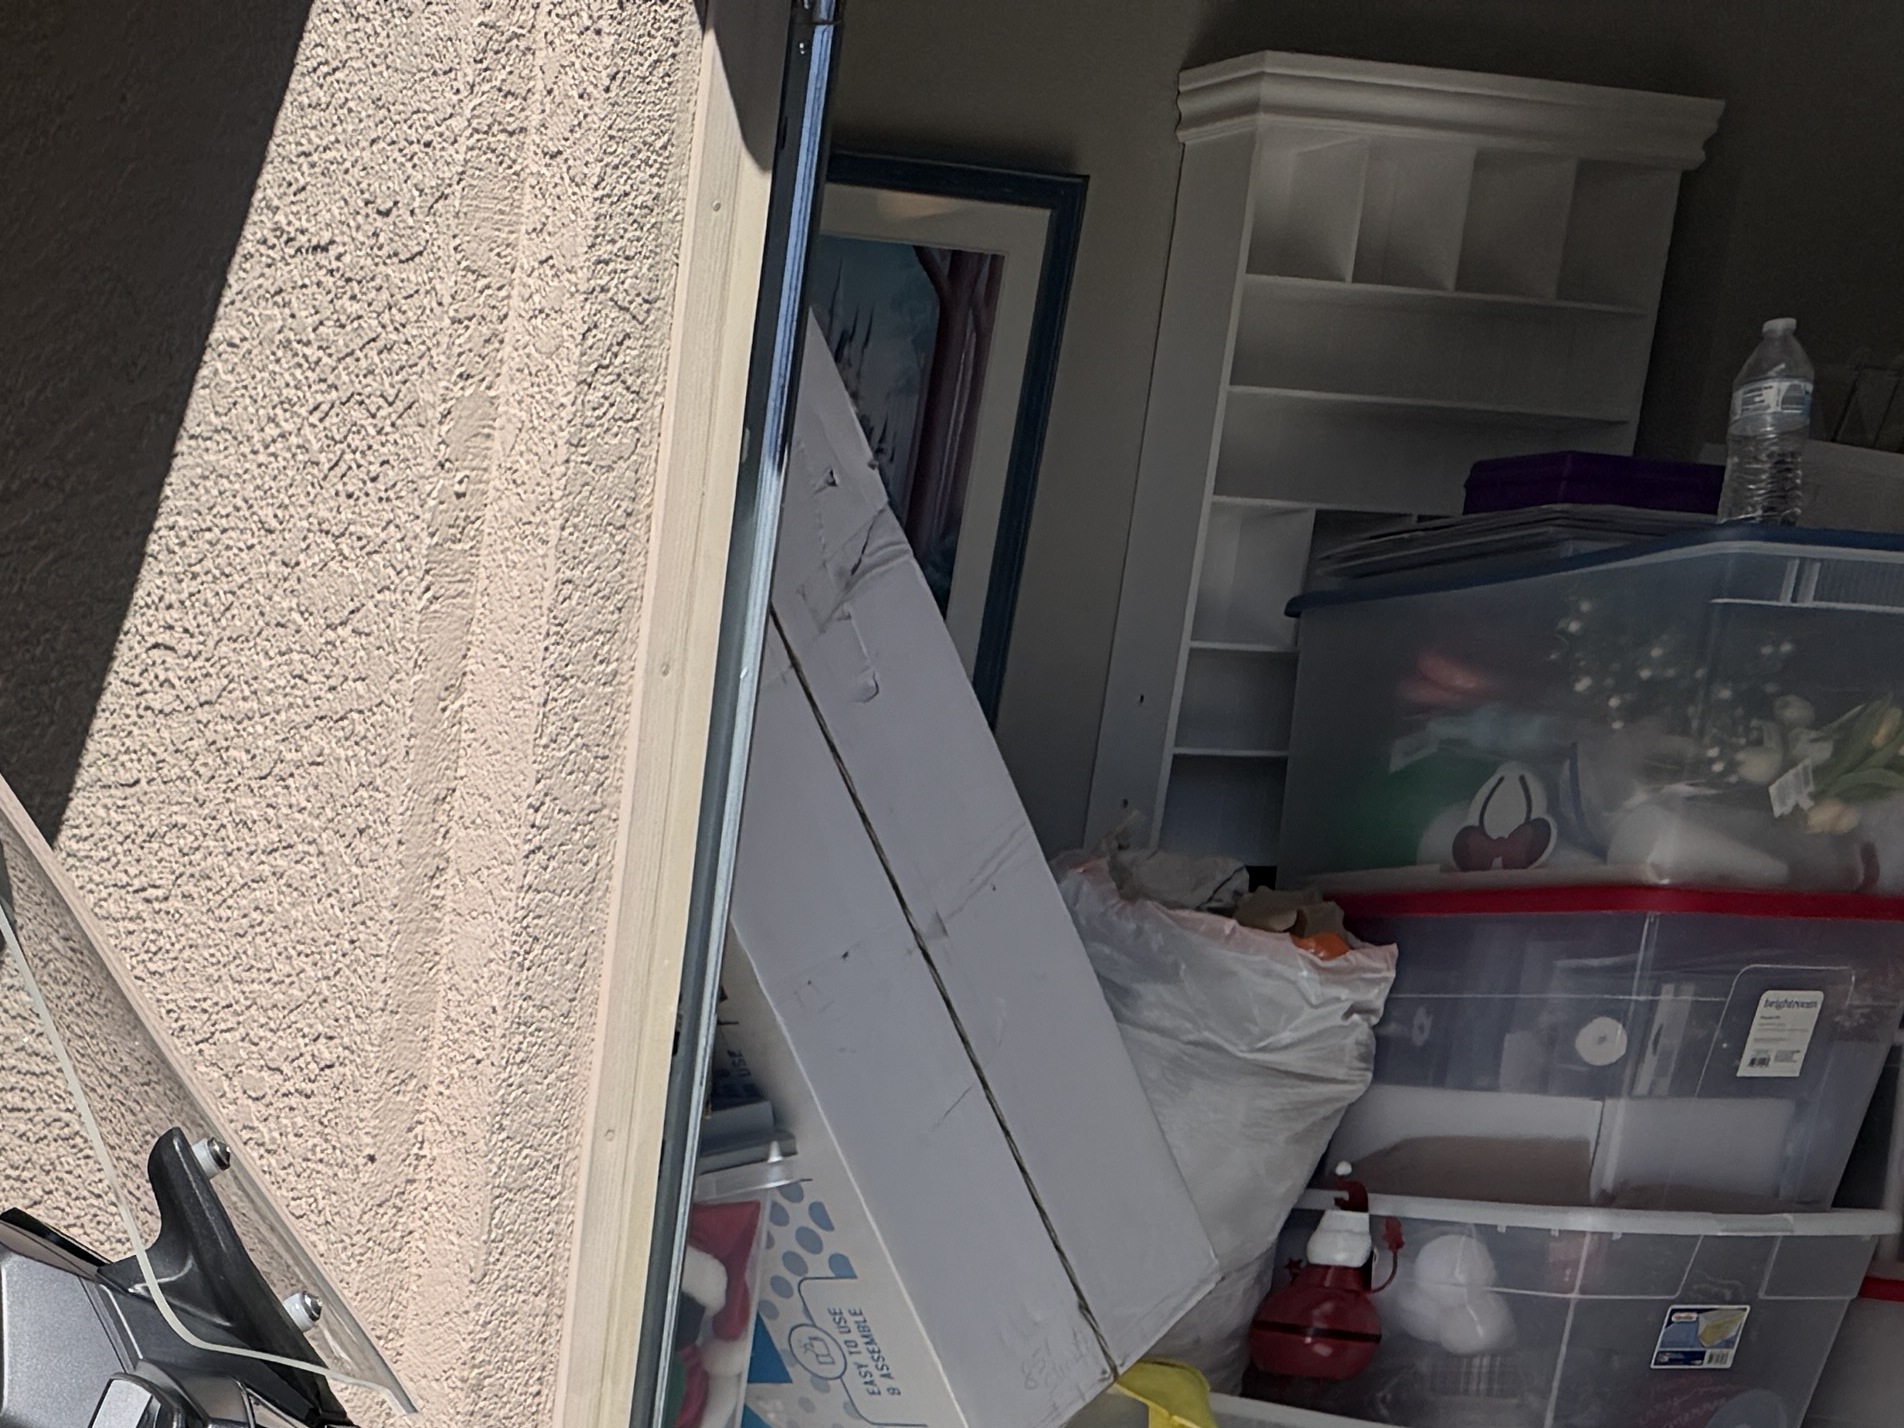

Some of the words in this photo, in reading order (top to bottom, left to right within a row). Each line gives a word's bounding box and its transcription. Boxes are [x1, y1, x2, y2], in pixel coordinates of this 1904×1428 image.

[827, 1306, 852, 1335] USE
[843, 1338, 863, 1356] TO
[847, 1307, 895, 1381] ASSEMBLE
[853, 1361, 882, 1397] EASY
